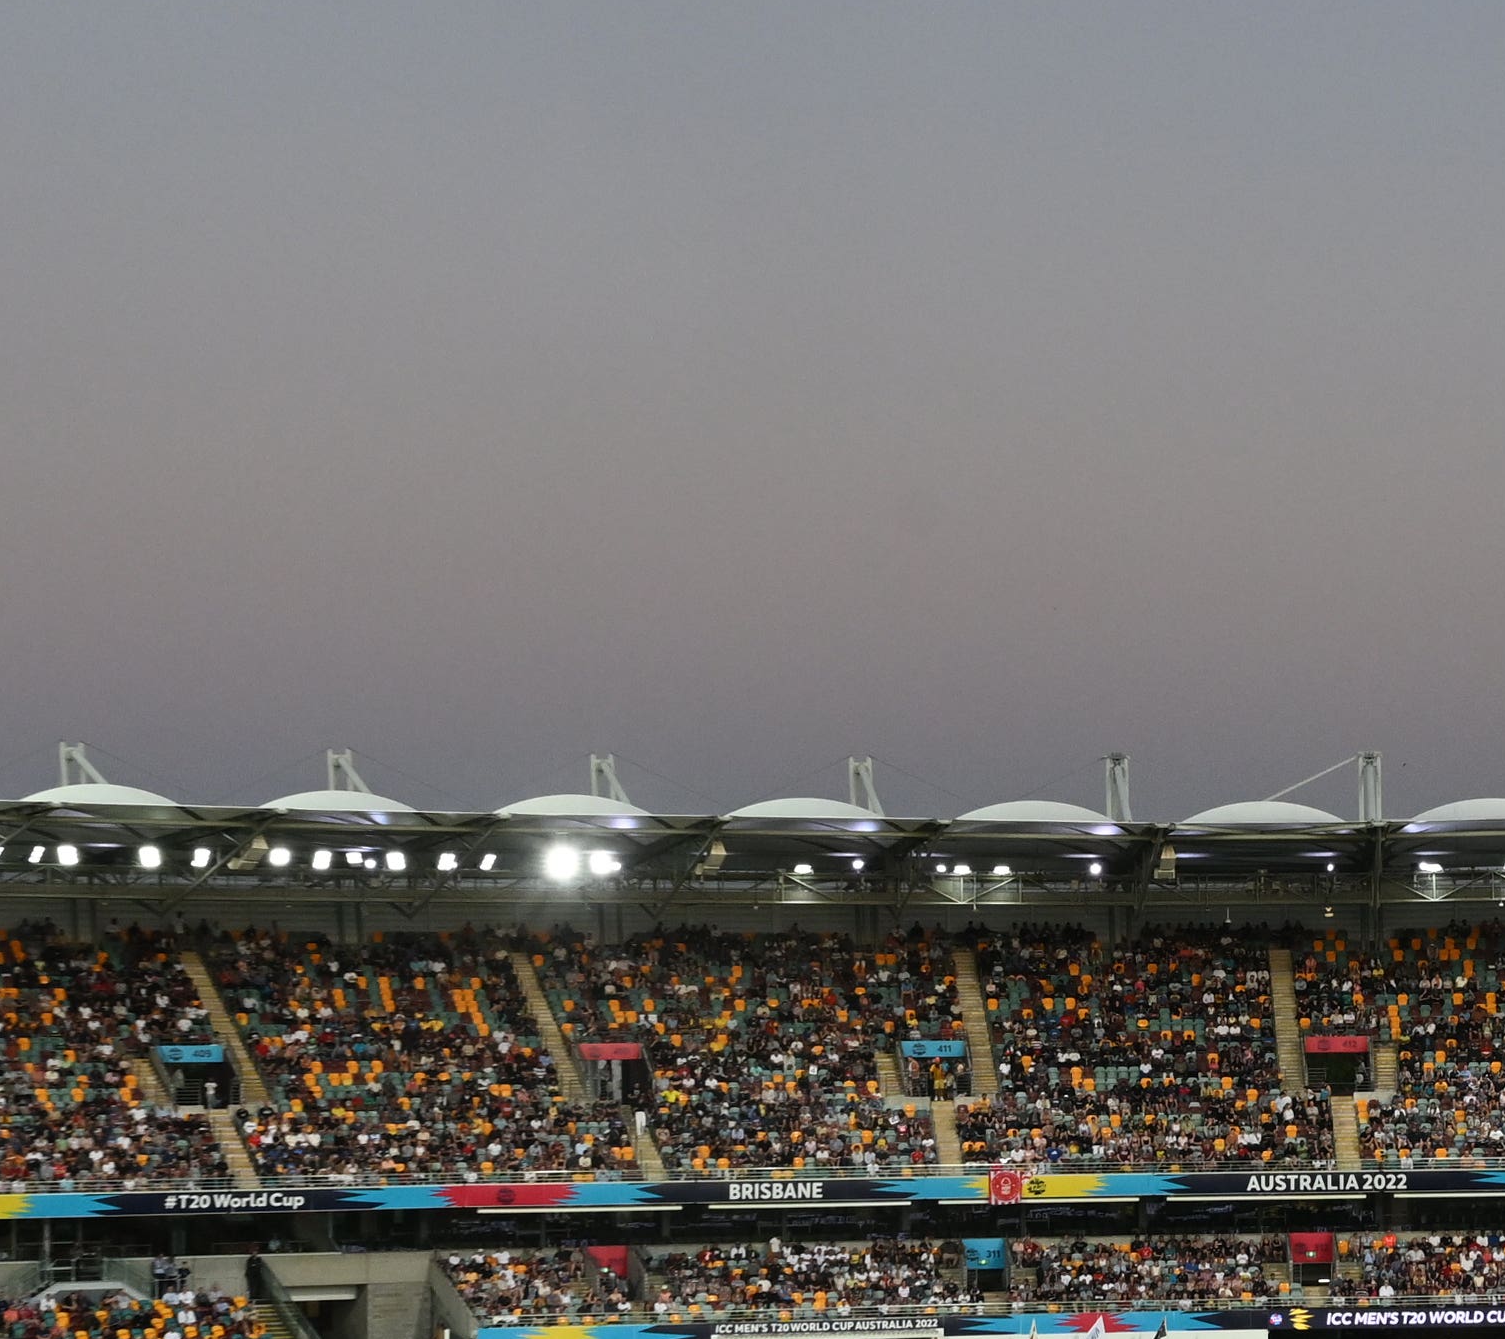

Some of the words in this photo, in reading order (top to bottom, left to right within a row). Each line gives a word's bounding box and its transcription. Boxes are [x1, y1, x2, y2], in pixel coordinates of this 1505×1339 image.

[1246, 1174, 1359, 1192] AUSTRALIA
[1362, 1173, 1407, 1190] 2022
[729, 1182, 823, 1200] BRISBANE
[164, 1195, 211, 1209] #T20
[213, 1193, 267, 1208] World
[269, 1193, 305, 1209] Cup
[715, 1324, 733, 1333] ICC
[734, 1323, 769, 1333] MEN'S
[770, 1323, 790, 1332] T20
[791, 1322, 830, 1332] WORLD
[831, 1321, 854, 1331] CUP
[854, 1319, 913, 1330] AUSTRALIA
[915, 1319, 938, 1328] 2022
[1326, 1313, 1352, 1325] ICC
[1354, 1312, 1399, 1324] MEN'S
[1401, 1312, 1426, 1324] T20
[1429, 1311, 1484, 1324] WORLD
